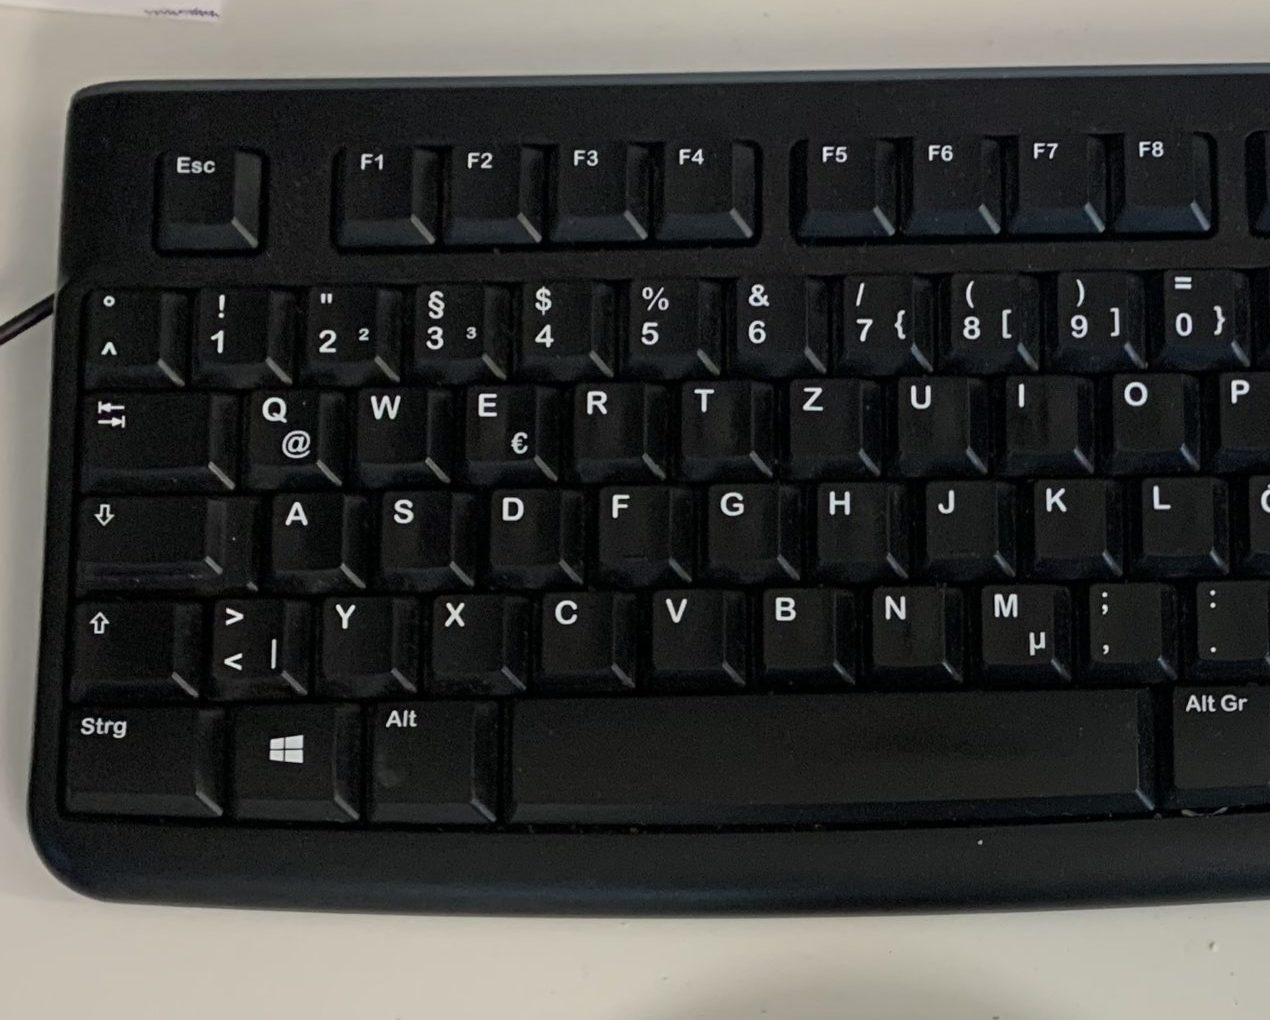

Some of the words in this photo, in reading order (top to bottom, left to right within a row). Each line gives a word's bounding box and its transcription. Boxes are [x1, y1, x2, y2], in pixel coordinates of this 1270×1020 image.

[467, 152, 493, 169] F2
[573, 149, 599, 167] F3
[678, 148, 705, 166] F4
[822, 146, 848, 163] F5
[928, 144, 954, 162] F6
[1033, 142, 1059, 160] F7
[1138, 140, 1165, 158] F8
[176, 156, 216, 174] Esc
[360, 153, 384, 171] F1
[534, 323, 555, 349] 4
[641, 321, 660, 346] 5
[748, 319, 767, 344] 6
[855, 318, 874, 343] 7
[962, 315, 981, 340] 8
[1070, 314, 1089, 339] 9
[1175, 312, 1193, 337] 0
[210, 329, 225, 354] 1
[318, 329, 337, 354] 2
[425, 325, 444, 351] 3
[586, 390, 608, 415] R
[693, 388, 715, 413] T
[802, 386, 824, 412] Z
[910, 384, 932, 410] U
[1018, 383, 1025, 408] I
[1123, 381, 1149, 407] O
[1230, 379, 1251, 405] P
[261, 396, 288, 424] Q
[370, 394, 402, 420] W
[477, 393, 498, 418] E
[281, 430, 311, 459] @
[510, 431, 529, 455] €
[502, 496, 525, 522] D
[611, 494, 631, 519] F
[720, 491, 745, 517] G
[829, 490, 851, 516] H
[937, 489, 955, 515] J
[1045, 487, 1068, 513] K
[1152, 485, 1172, 510] L
[284, 501, 309, 527] A
[393, 498, 415, 525] S
[335, 603, 356, 630] Y
[444, 602, 466, 628] X
[554, 599, 578, 625] C
[665, 598, 688, 624] V
[775, 596, 797, 622] B
[884, 595, 907, 621] N
[993, 593, 1019, 618] M
[1185, 694, 1216, 713] Alt
[1220, 694, 1248, 713] Gr
[80, 717, 128, 739] Strg
[385, 709, 418, 728] Alt
